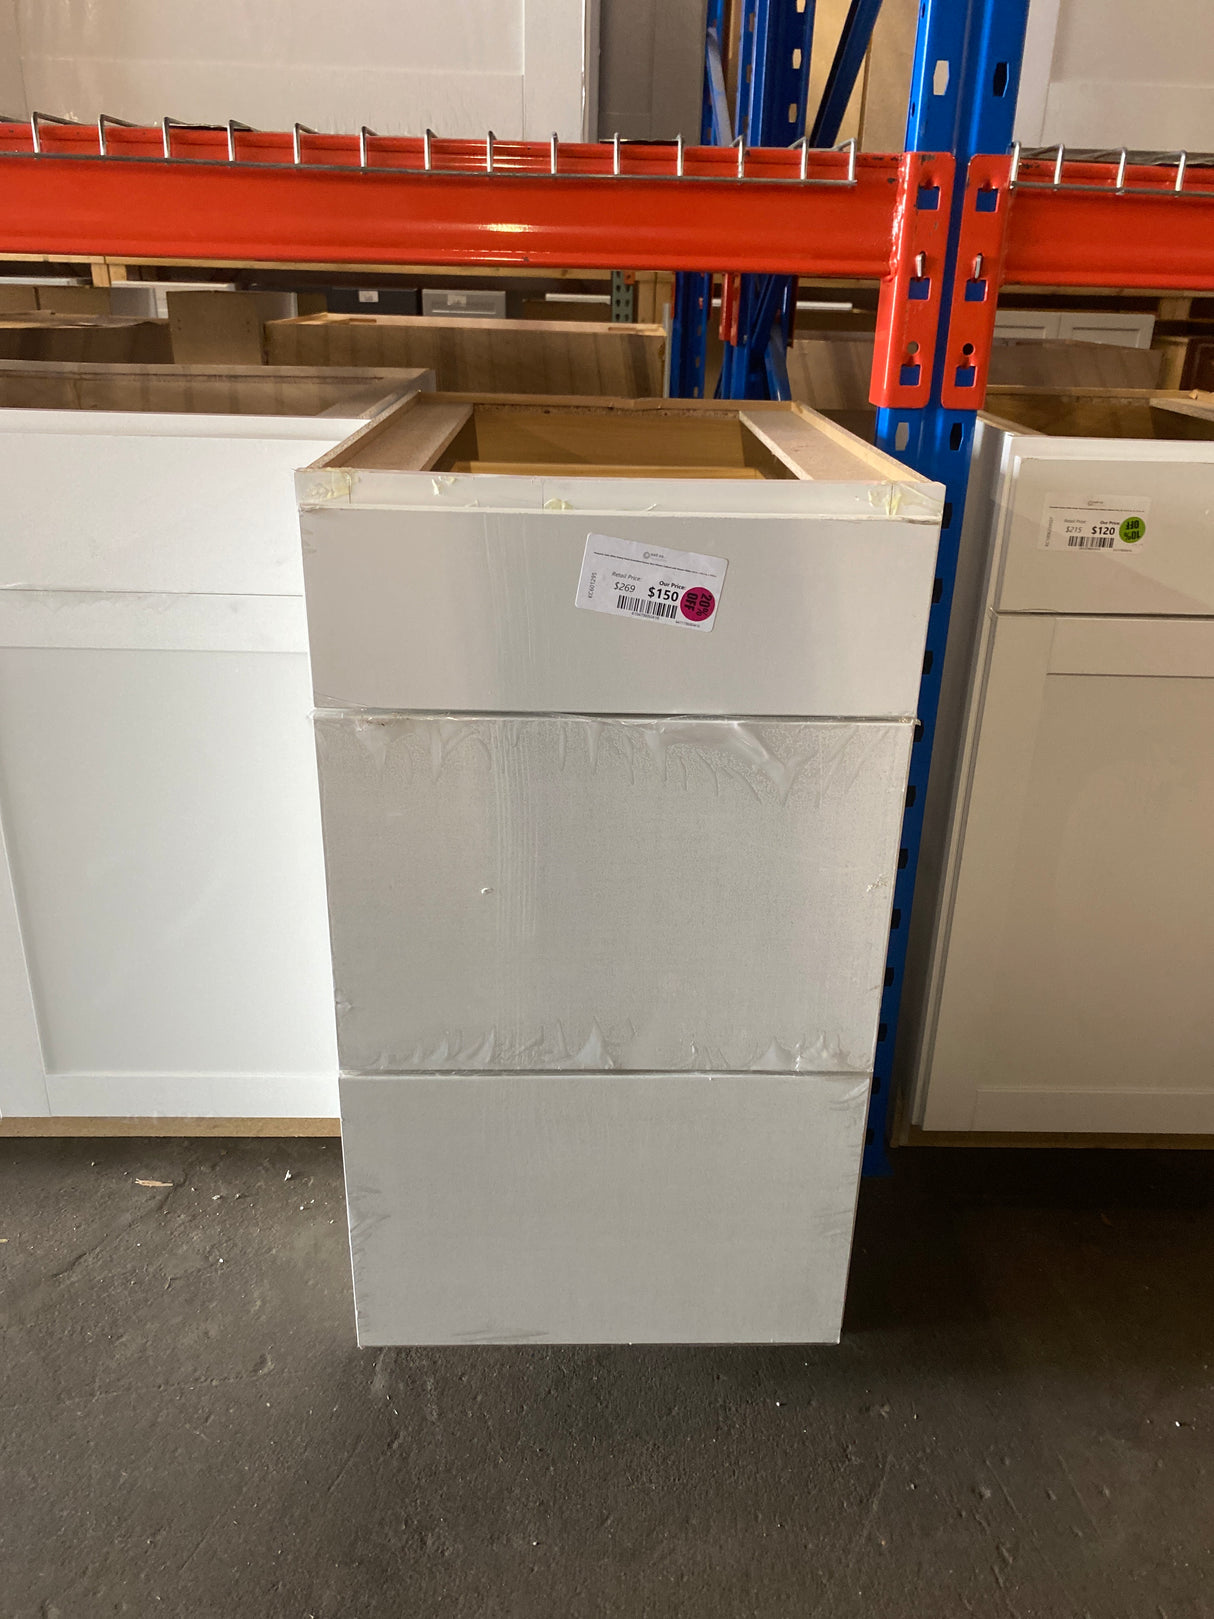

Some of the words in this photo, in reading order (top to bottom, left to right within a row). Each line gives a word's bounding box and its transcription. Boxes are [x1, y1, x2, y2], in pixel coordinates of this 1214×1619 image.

[1065, 525, 1083, 534] $215
[1125, 519, 1140, 530] OFF
[1091, 526, 1116, 535] $120
[1123, 530, 1141, 541] 10%
[611, 571, 627, 579] Retail
[613, 581, 636, 593] $269
[647, 586, 679, 602] $150
[684, 592, 699, 612] OFF
[696, 592, 713, 617] 20%
